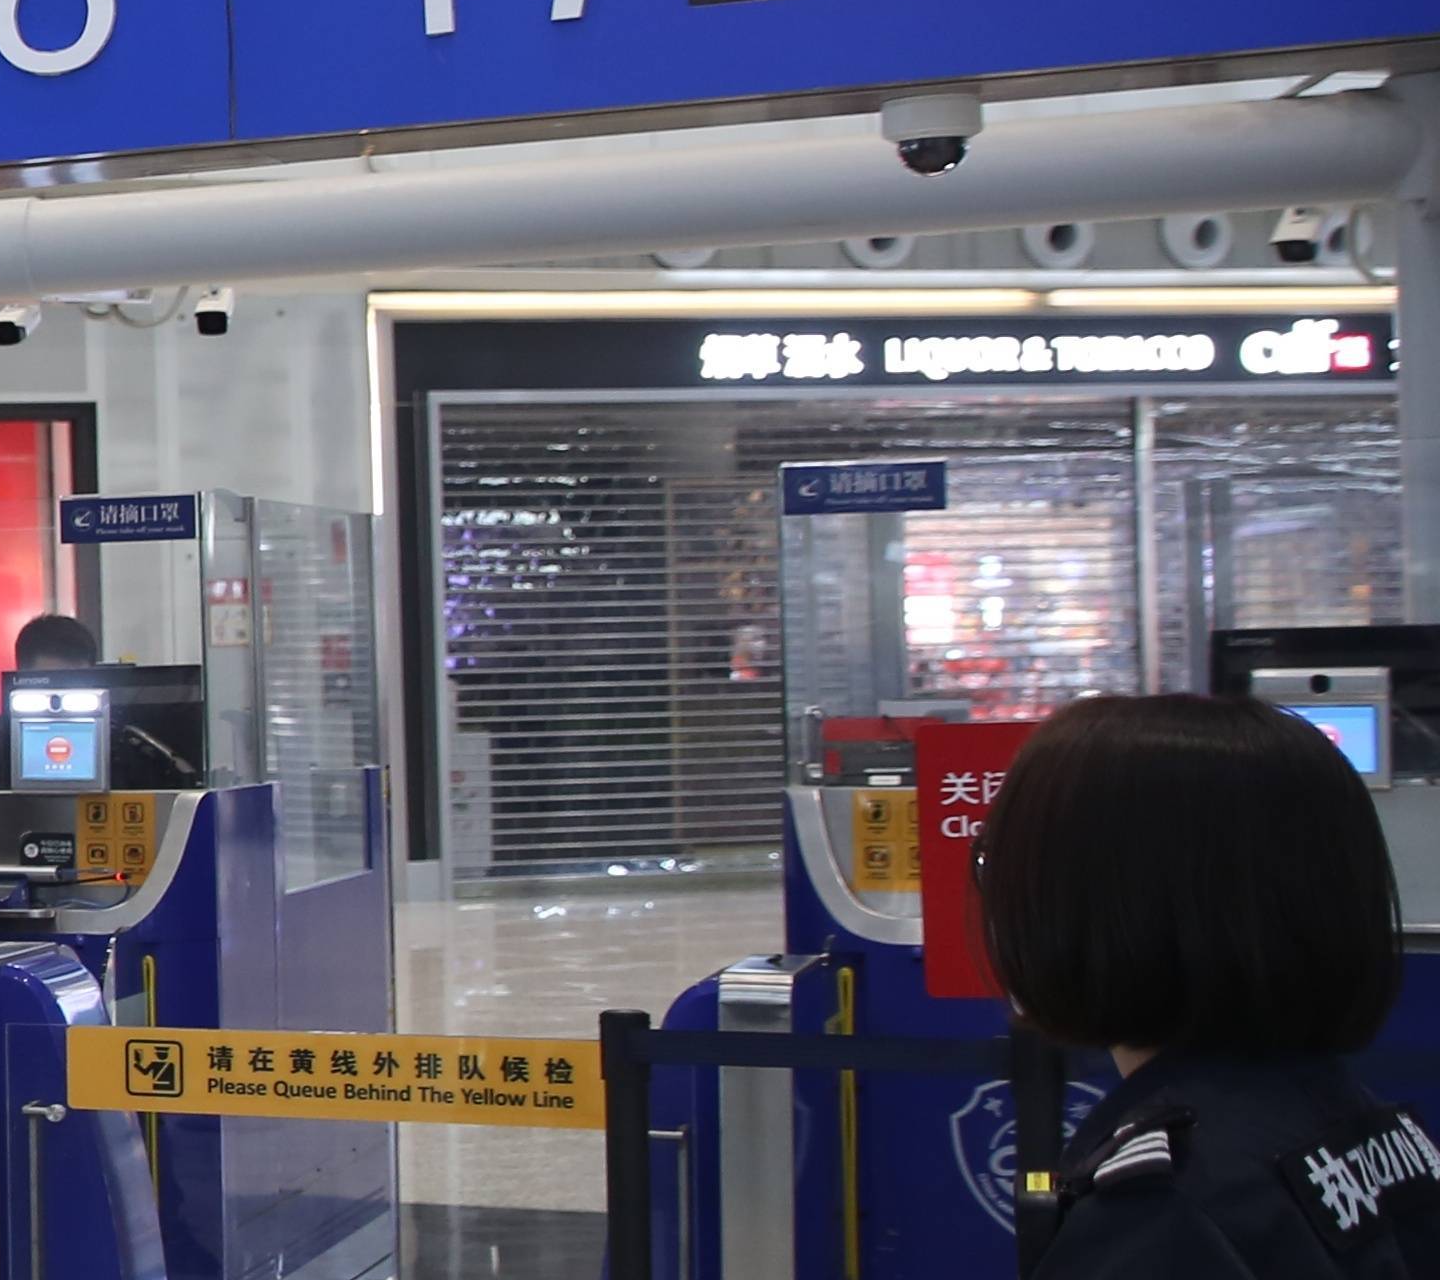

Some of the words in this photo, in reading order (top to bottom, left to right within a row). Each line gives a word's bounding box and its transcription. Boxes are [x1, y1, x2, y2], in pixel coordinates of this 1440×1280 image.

[100, 502, 179, 524] 请摘口罩
[207, 1045, 575, 1084] 请在黄线外排队候检
[207, 1077, 267, 1096] Please
[273, 1080, 337, 1102] Queue
[343, 1082, 412, 1102] Behind
[418, 1085, 454, 1104] The
[458, 1087, 526, 1108] Yellow
[533, 1089, 575, 1109] Line
